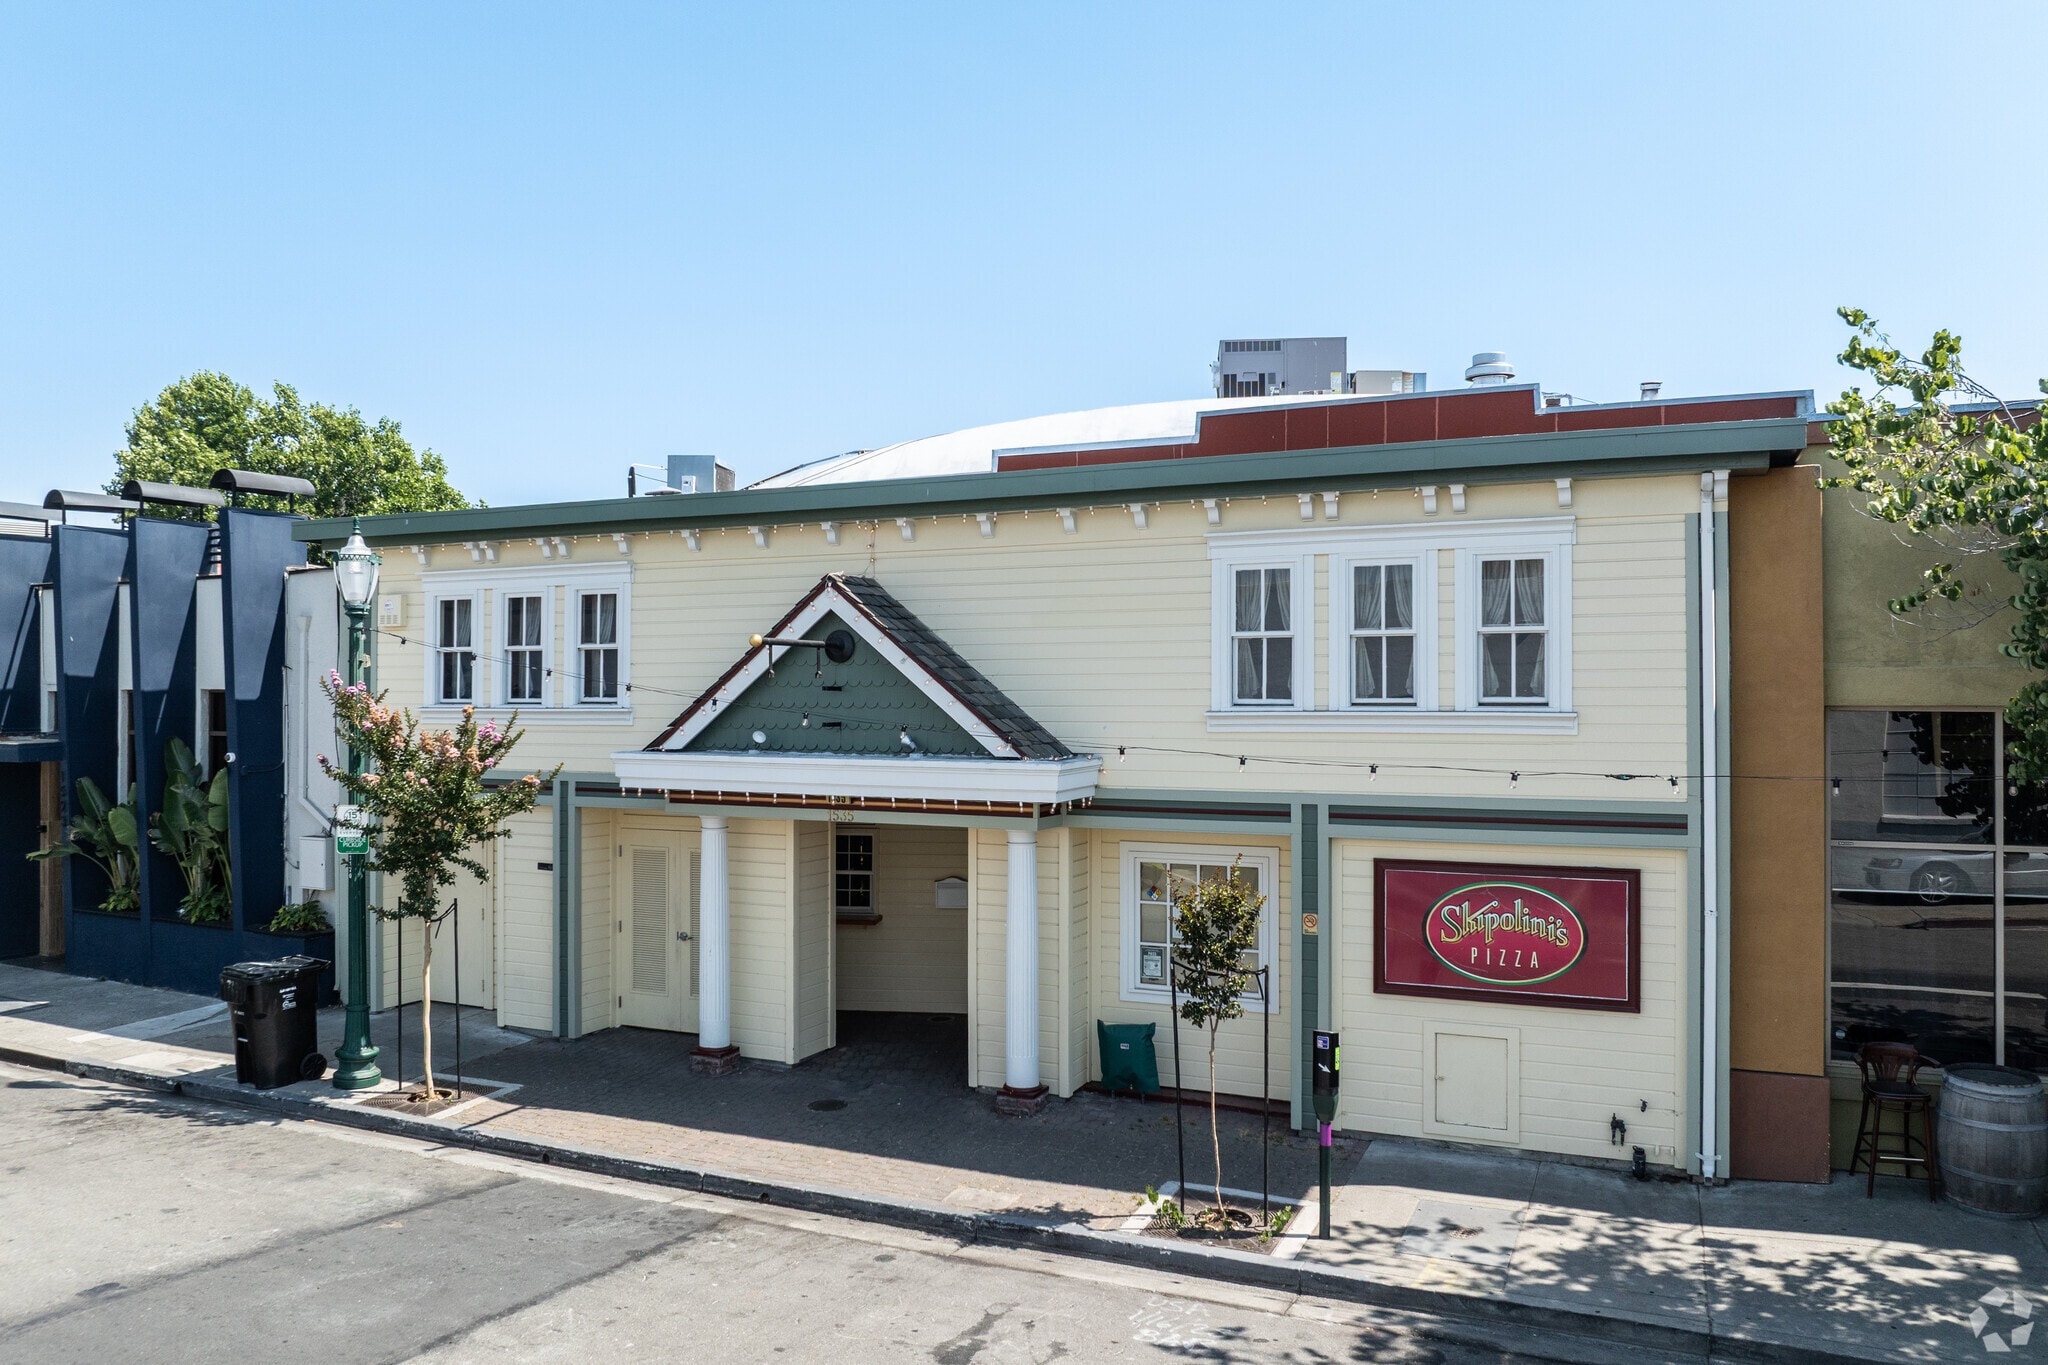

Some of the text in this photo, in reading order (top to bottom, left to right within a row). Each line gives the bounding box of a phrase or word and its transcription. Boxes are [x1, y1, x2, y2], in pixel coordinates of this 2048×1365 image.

[348, 811, 358, 819] 15
[827, 810, 854, 822] 1535
[1440, 898, 1569, 947] Skipolini's
[1471, 947, 1539, 968] PIZZA
